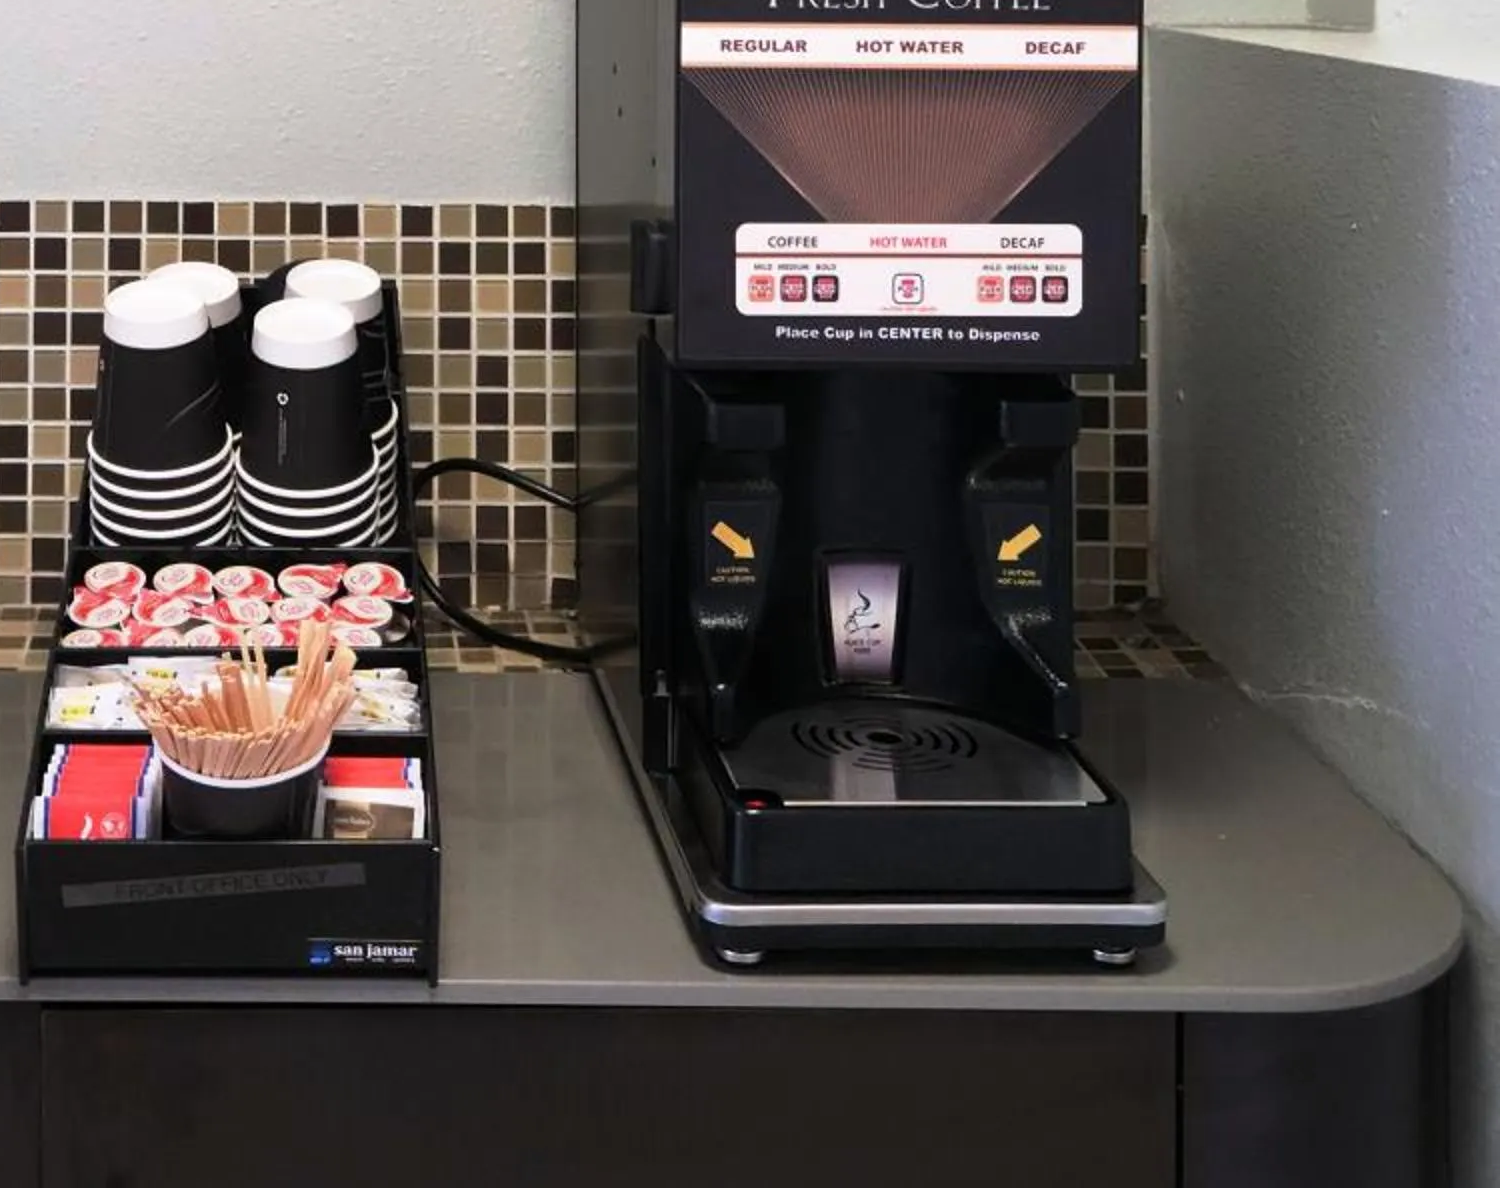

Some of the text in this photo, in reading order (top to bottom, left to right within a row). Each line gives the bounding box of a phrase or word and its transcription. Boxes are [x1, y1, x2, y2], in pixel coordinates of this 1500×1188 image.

[719, 39, 808, 53] REGULAR
[855, 40, 964, 54] HOT WATER
[1025, 41, 1087, 55] DECAF
[767, 235, 819, 249] COFFEE
[869, 236, 947, 249] HOT WATER
[1000, 237, 1046, 250] DECAF
[775, 325, 1041, 344] Place Cup in CENTER to Dispense
[115, 868, 331, 900] FRONT OFFICE ONLY
[333, 943, 418, 959] san jamar
